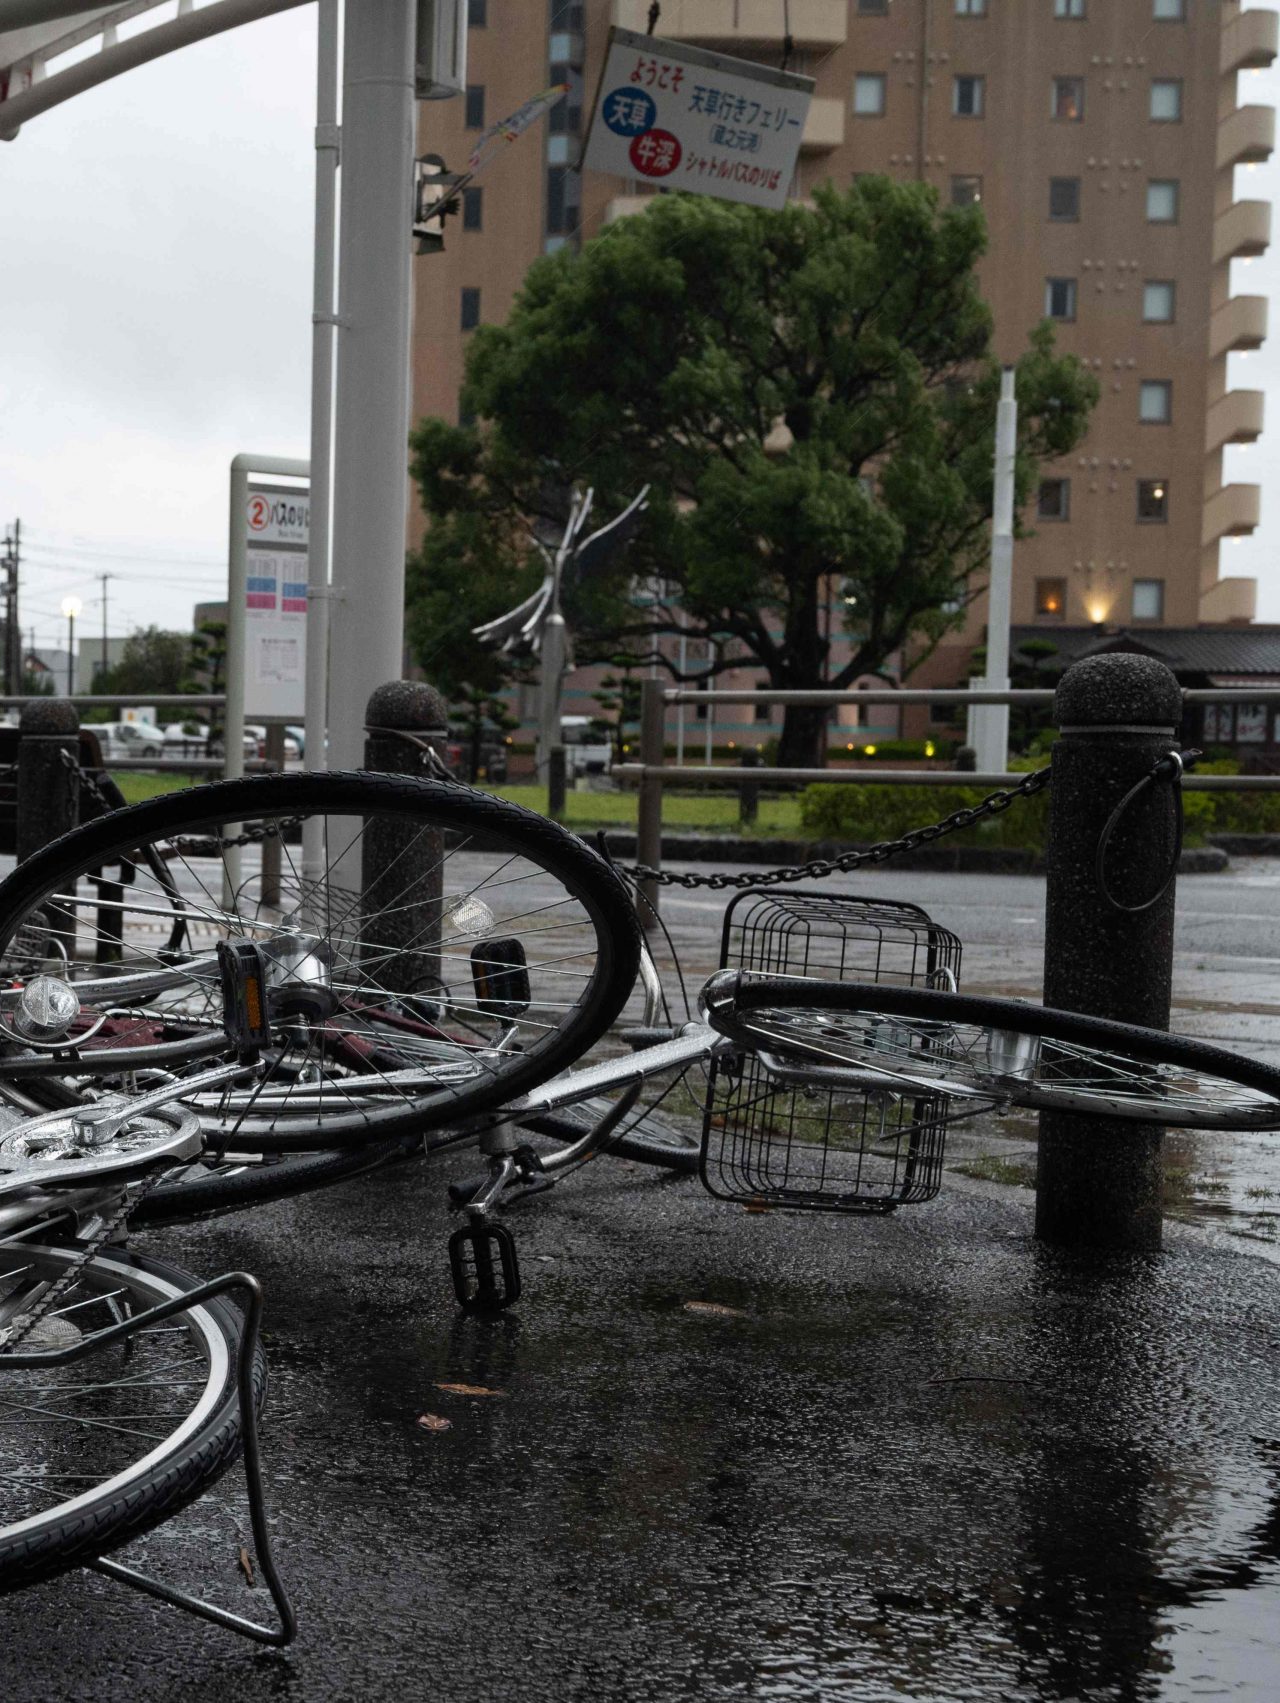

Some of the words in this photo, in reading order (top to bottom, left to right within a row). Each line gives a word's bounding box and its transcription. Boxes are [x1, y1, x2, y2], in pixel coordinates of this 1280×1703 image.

[630, 57, 684, 93] ようこそ
[609, 96, 650, 129] 天草
[688, 85, 800, 132] 天草行きフェリー
[637, 135, 676, 169] 牛深
[686, 153, 781, 190] シャトルバスのりば
